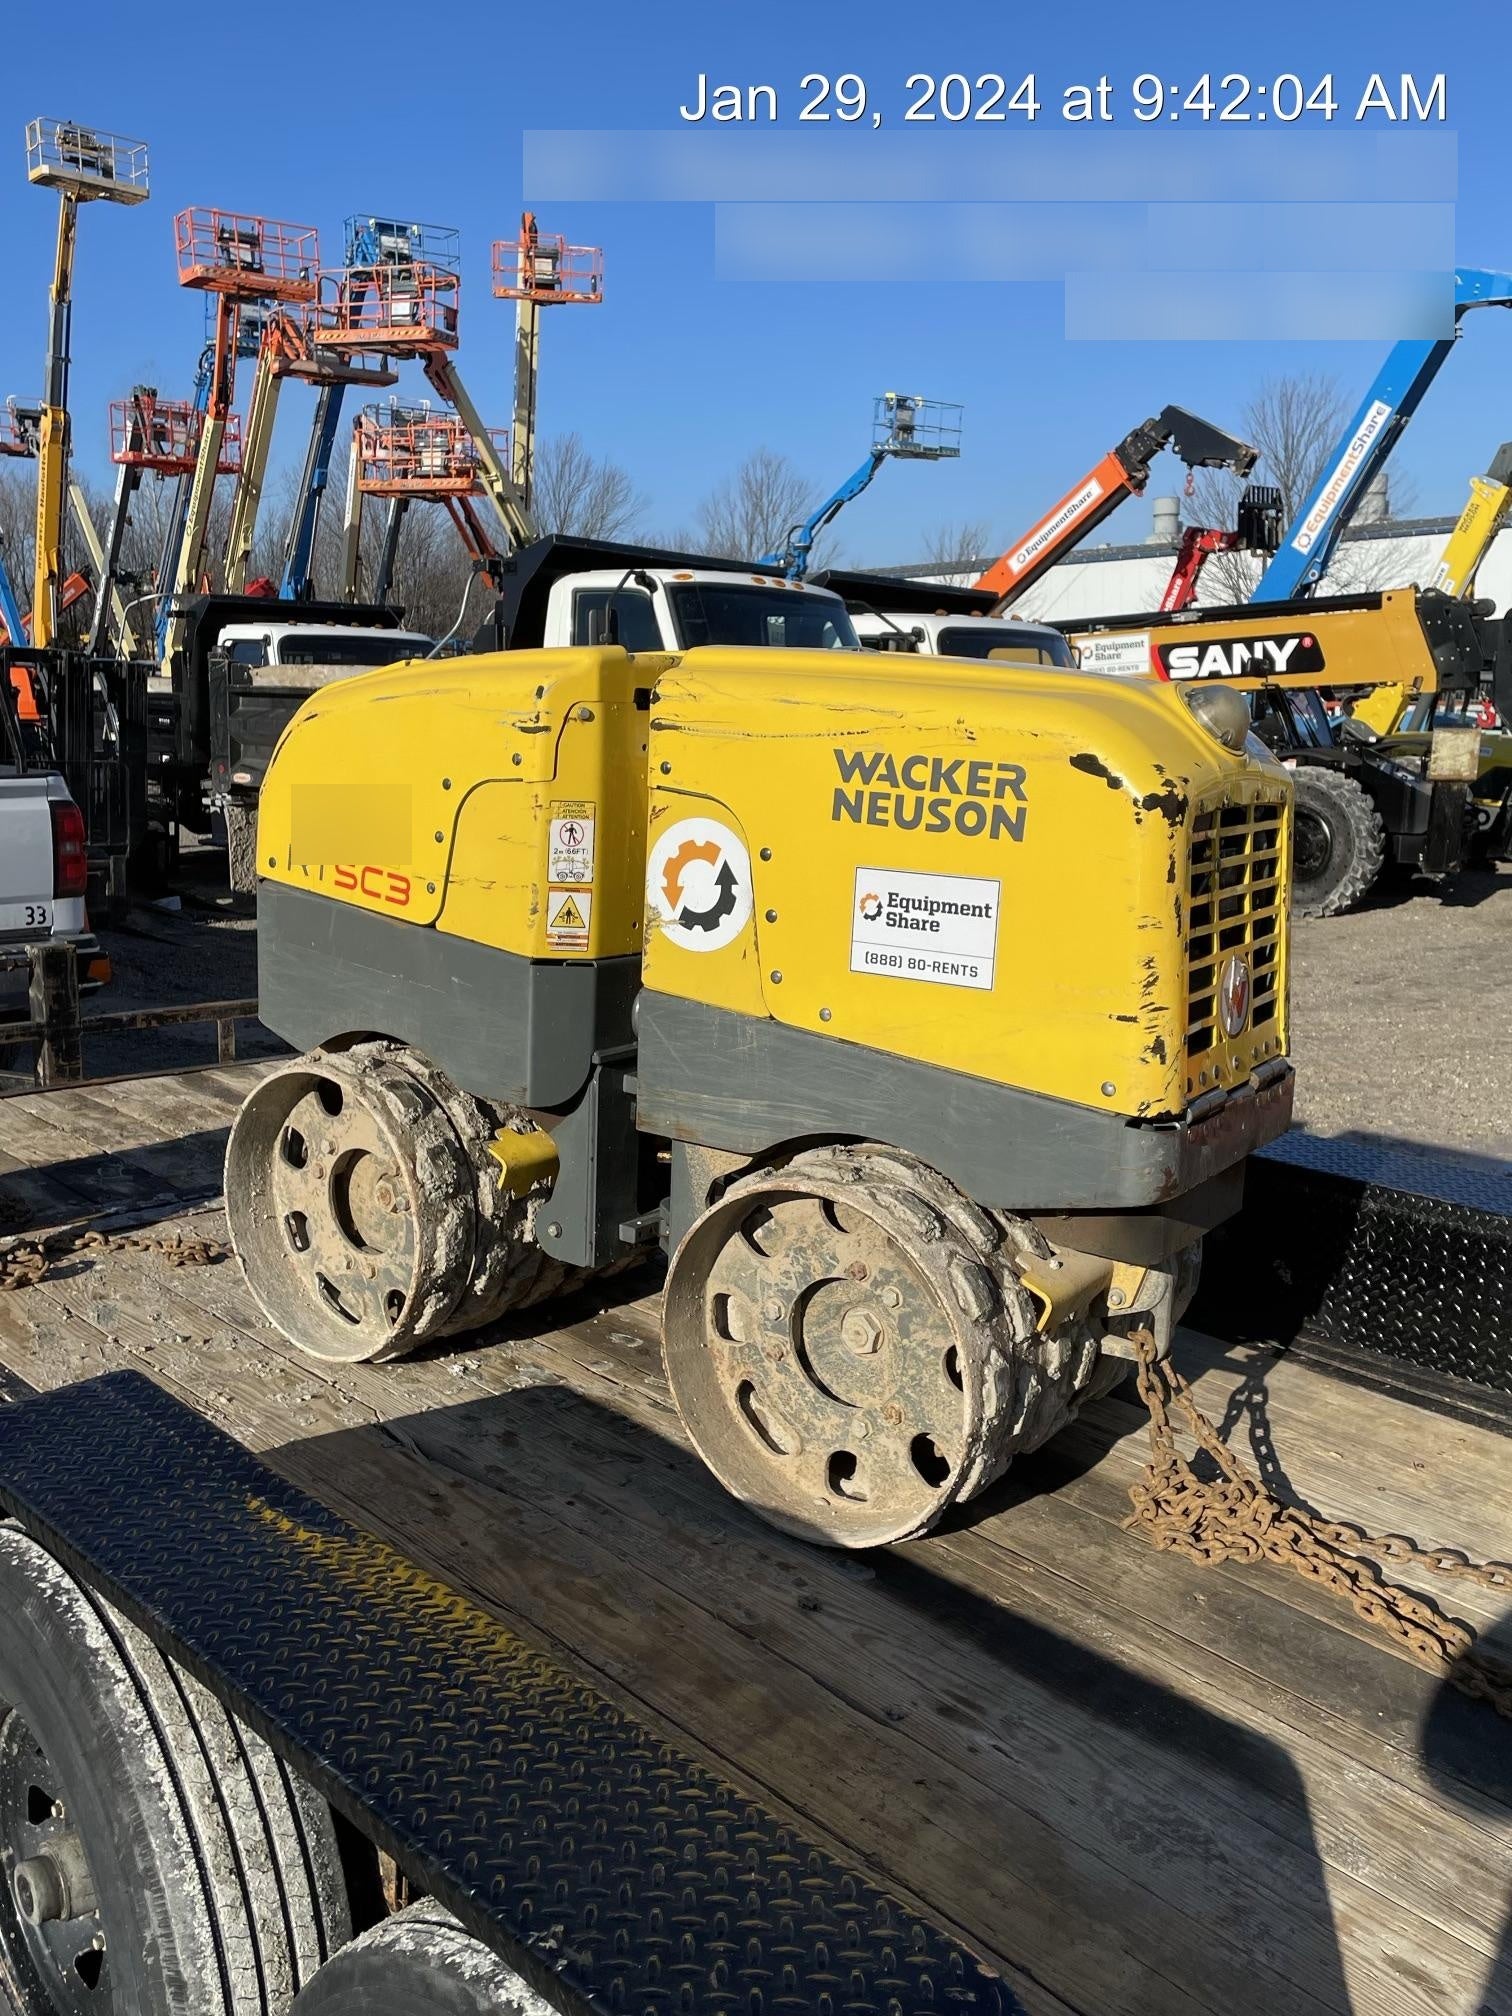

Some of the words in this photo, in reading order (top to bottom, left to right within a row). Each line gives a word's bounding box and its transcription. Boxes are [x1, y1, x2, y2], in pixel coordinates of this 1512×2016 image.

[188, 425, 211, 523] EquipmentShare
[1306, 405, 1387, 534] EquipmentShare
[1024, 490, 1093, 556] EquipmentShare
[1094, 640, 1145, 652] Equipment
[1094, 652, 1122, 661] Share
[1168, 638, 1299, 679] SANY
[833, 748, 1028, 801] WACKER
[831, 788, 1027, 843] NEUSON
[25, 905, 47, 926] 33
[885, 911, 941, 933] Share
[886, 891, 993, 919] Equipment
[864, 951, 903, 969] (888)
[907, 957, 979, 979] 80-RENTS
